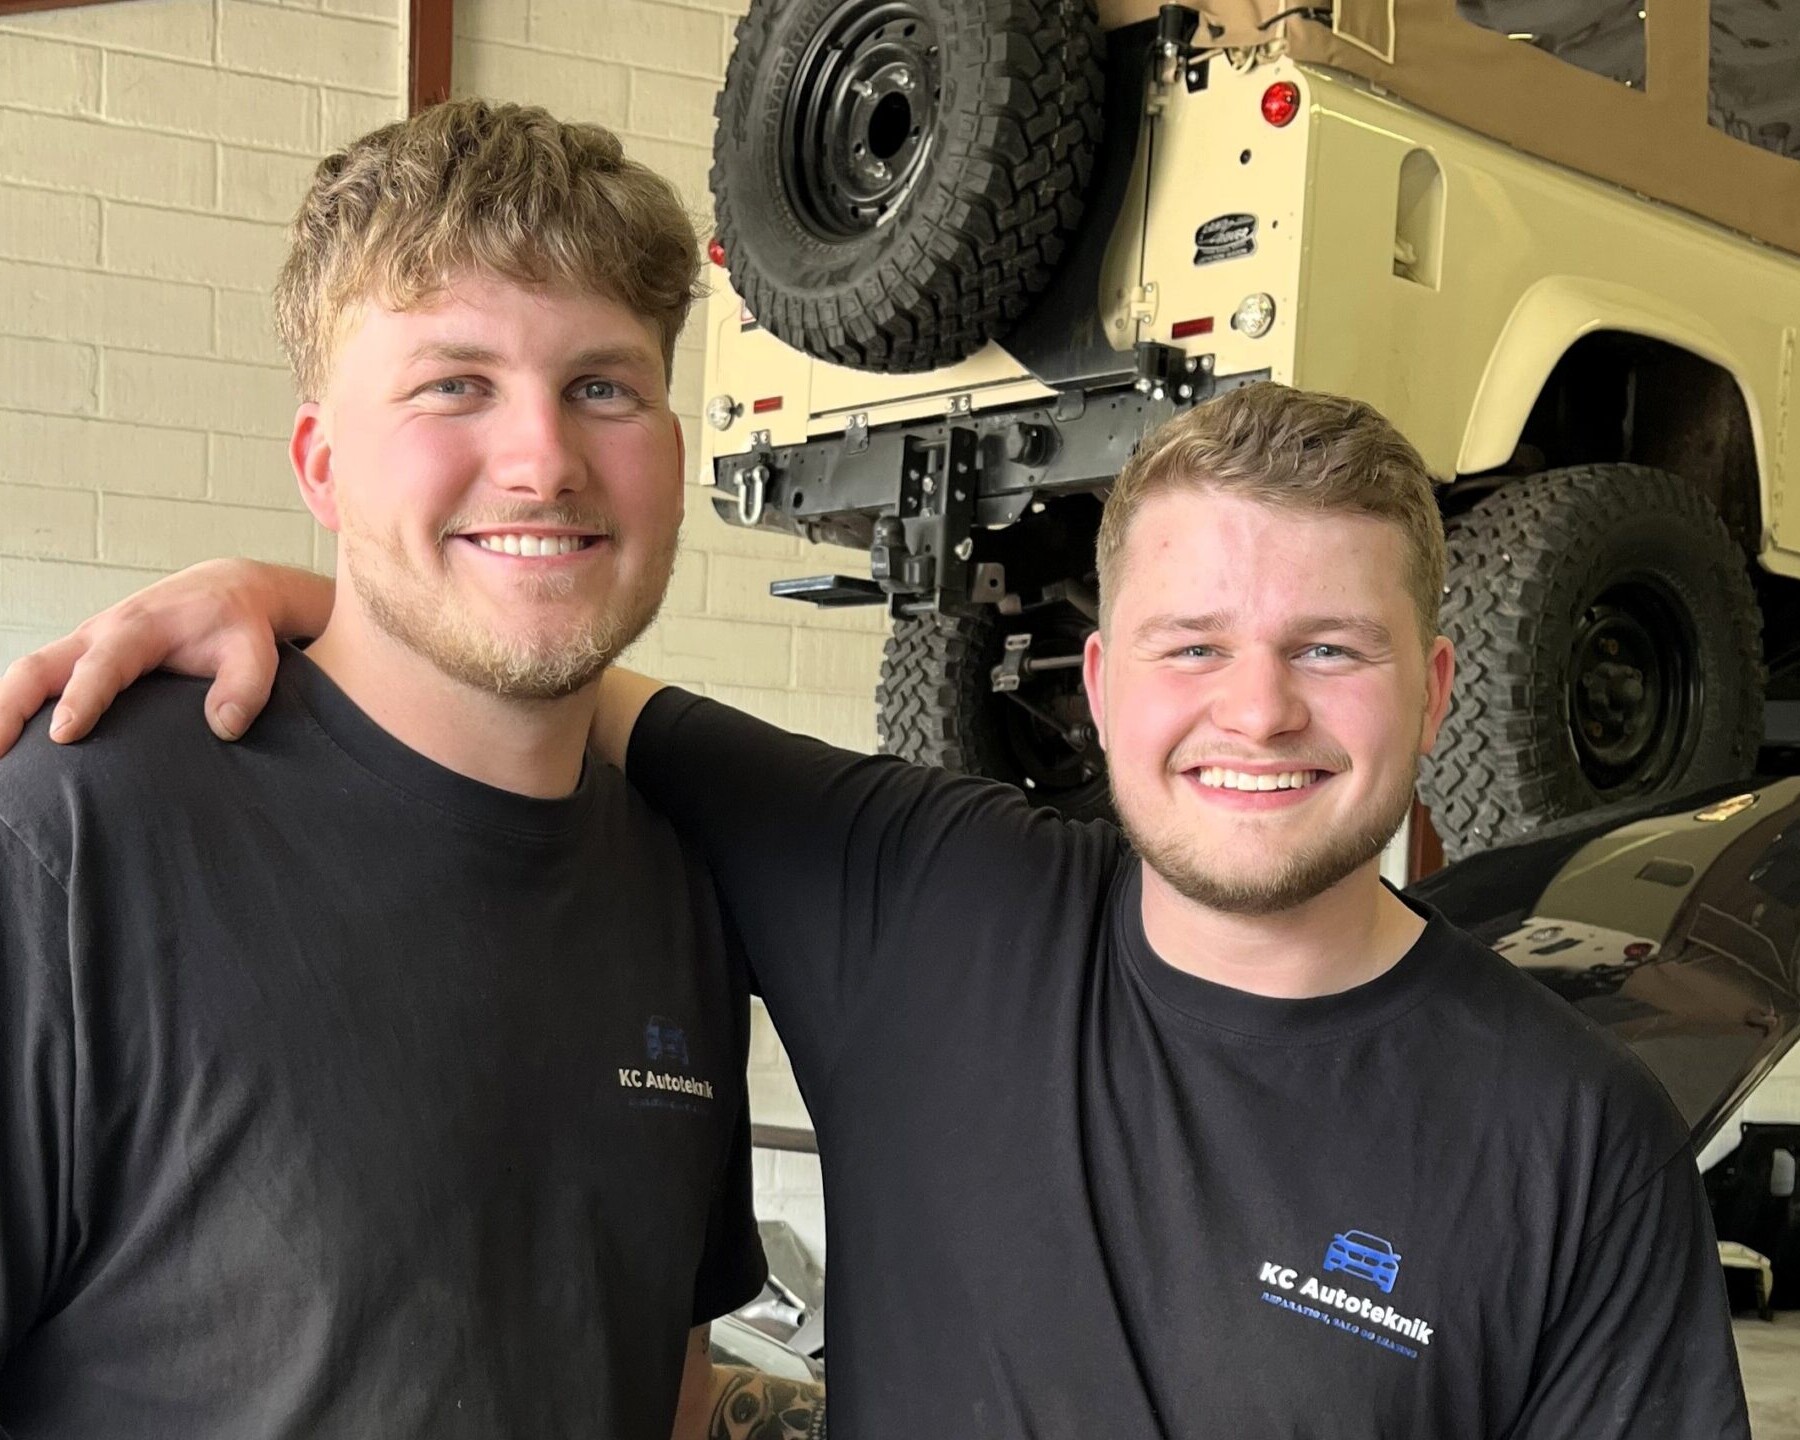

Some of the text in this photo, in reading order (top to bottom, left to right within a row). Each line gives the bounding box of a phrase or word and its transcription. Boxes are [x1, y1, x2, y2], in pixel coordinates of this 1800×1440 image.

[618, 1068, 714, 1099] KC Autoteknik
[1259, 1261, 1434, 1345] KC Autoteknik
